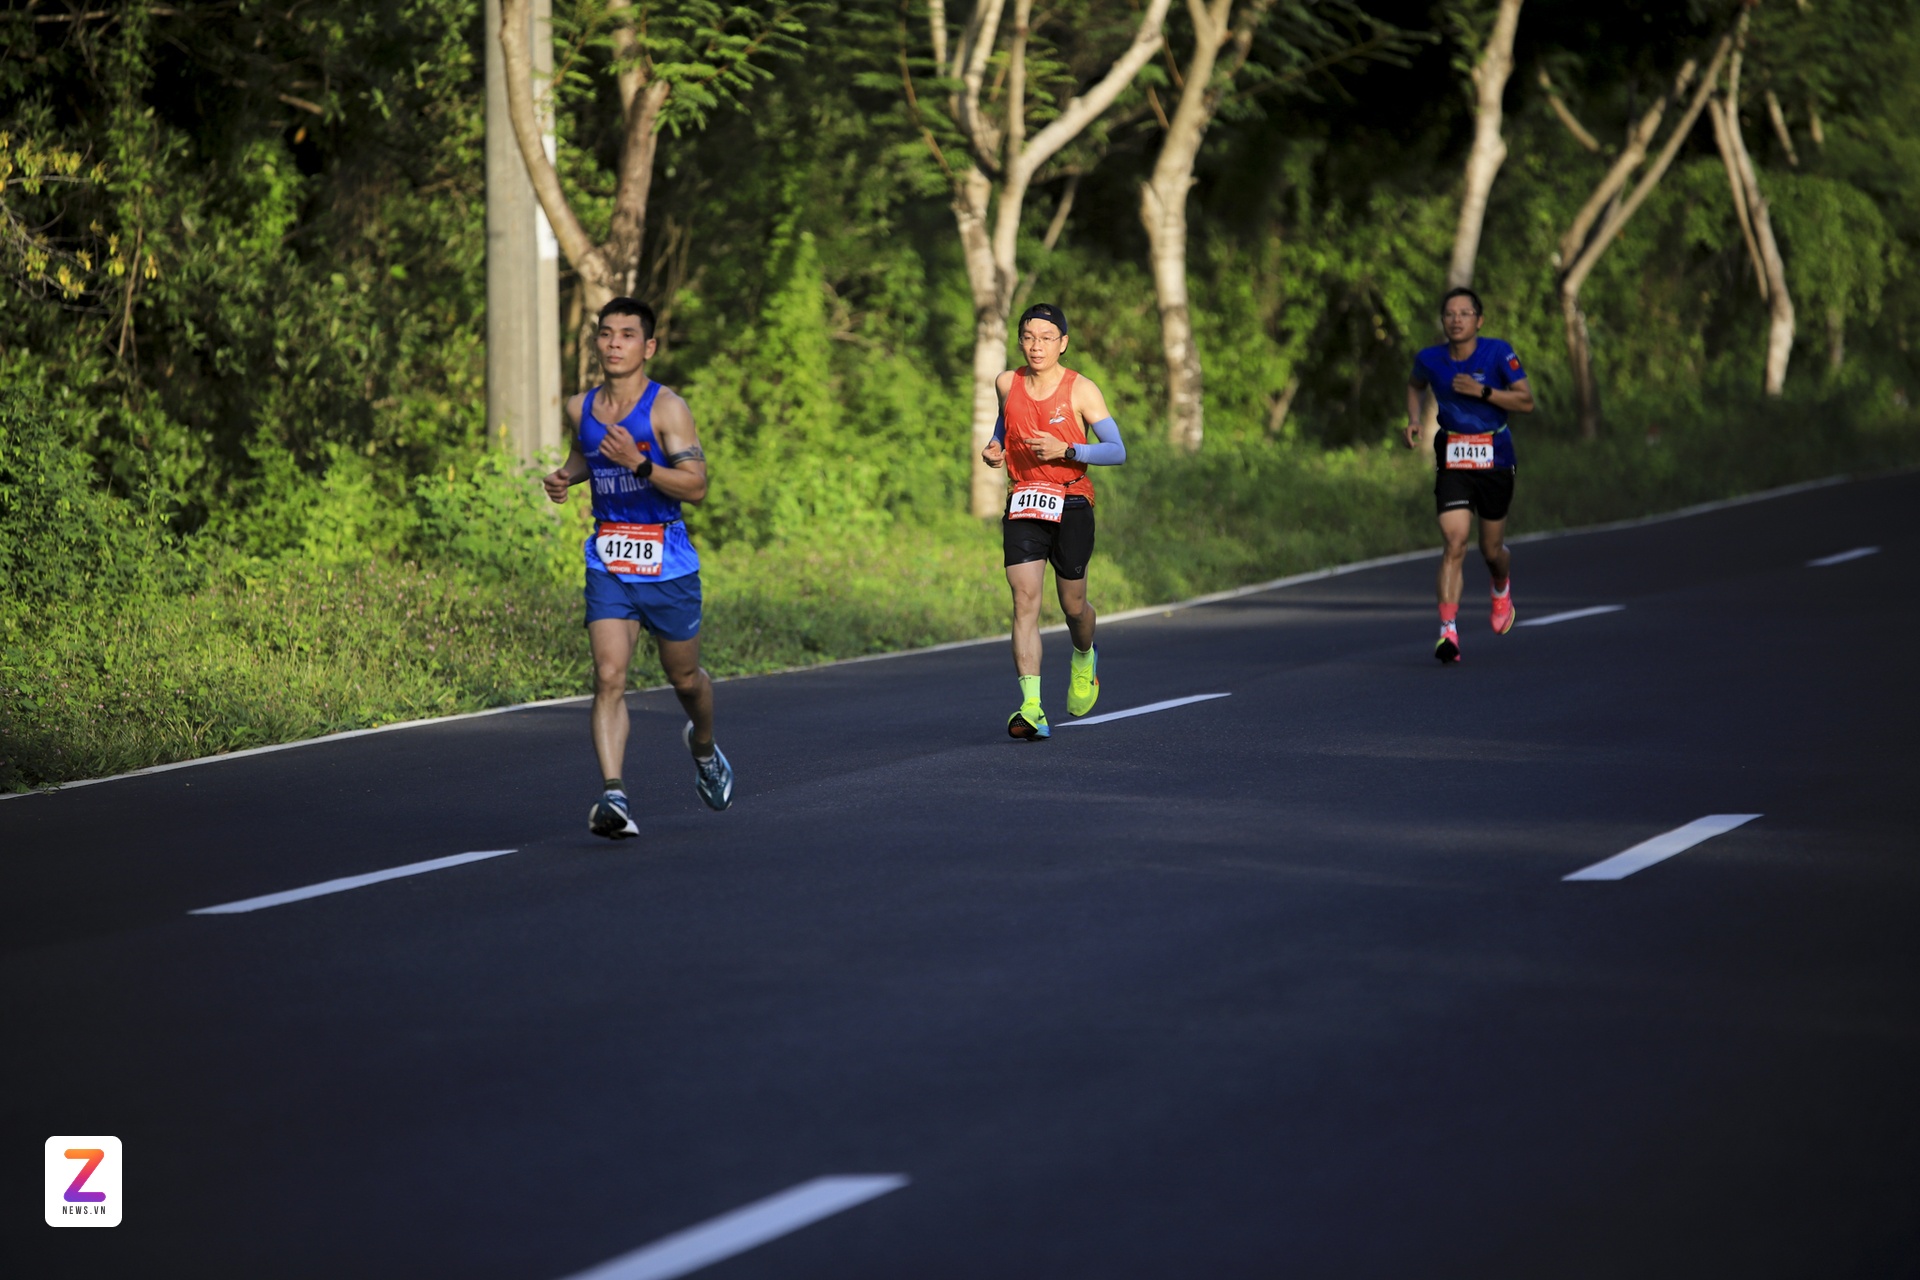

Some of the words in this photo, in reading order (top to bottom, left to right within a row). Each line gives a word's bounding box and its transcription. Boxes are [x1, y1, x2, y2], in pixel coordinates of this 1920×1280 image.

[1453, 446, 1487, 458] 41414
[1018, 494, 1057, 510] 41166
[605, 540, 653, 560] 41218
